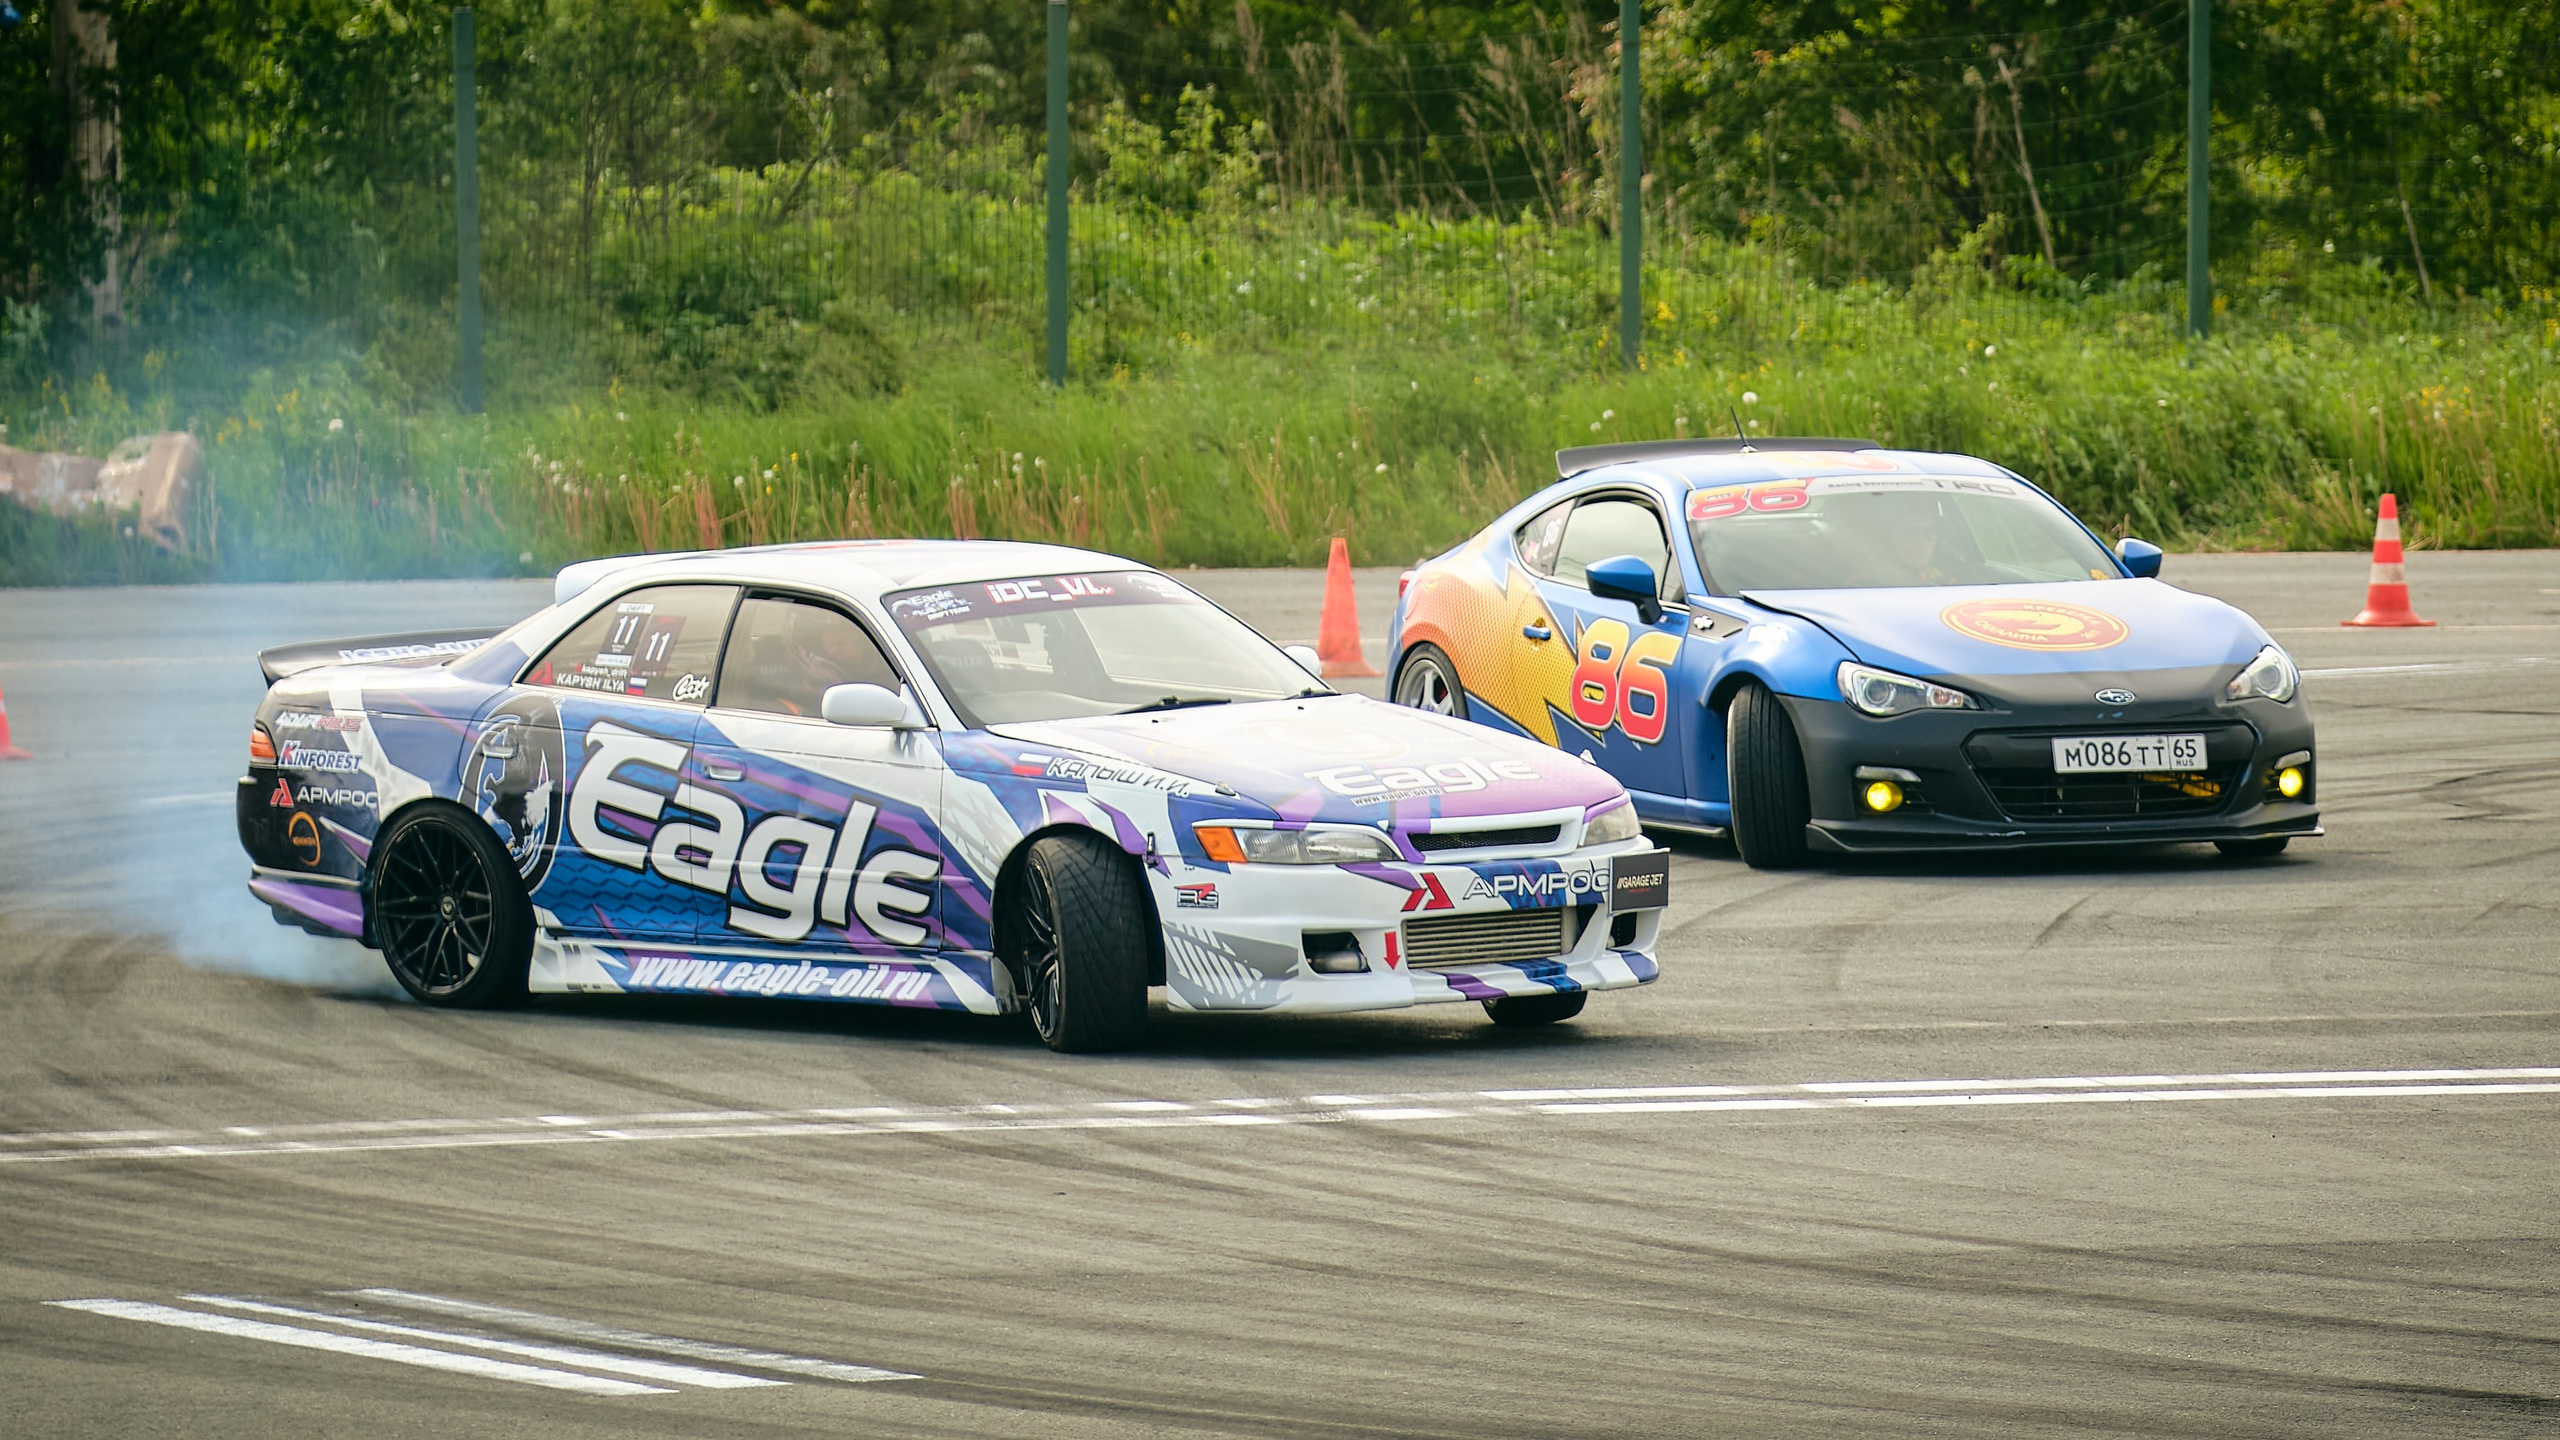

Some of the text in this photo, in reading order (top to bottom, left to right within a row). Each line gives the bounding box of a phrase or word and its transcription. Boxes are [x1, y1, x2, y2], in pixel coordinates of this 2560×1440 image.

[1688, 480, 1810, 520] 86
[1920, 478, 2016, 495] TRD
[909, 590, 954, 607] Eagle
[613, 615, 639, 645] 11
[645, 631, 670, 662] 11
[556, 672, 625, 693] KAPYSH ILYA
[1570, 617, 1683, 745] 86
[279, 740, 362, 773] KINFOREST
[2172, 738, 2197, 758] 65
[2175, 759, 2194, 767] RUS
[1302, 756, 1542, 796] Eagle
[569, 720, 941, 945] Eagle
[1649, 873, 1664, 887] JET
[628, 955, 932, 1001] www.eagle-oil.ru
